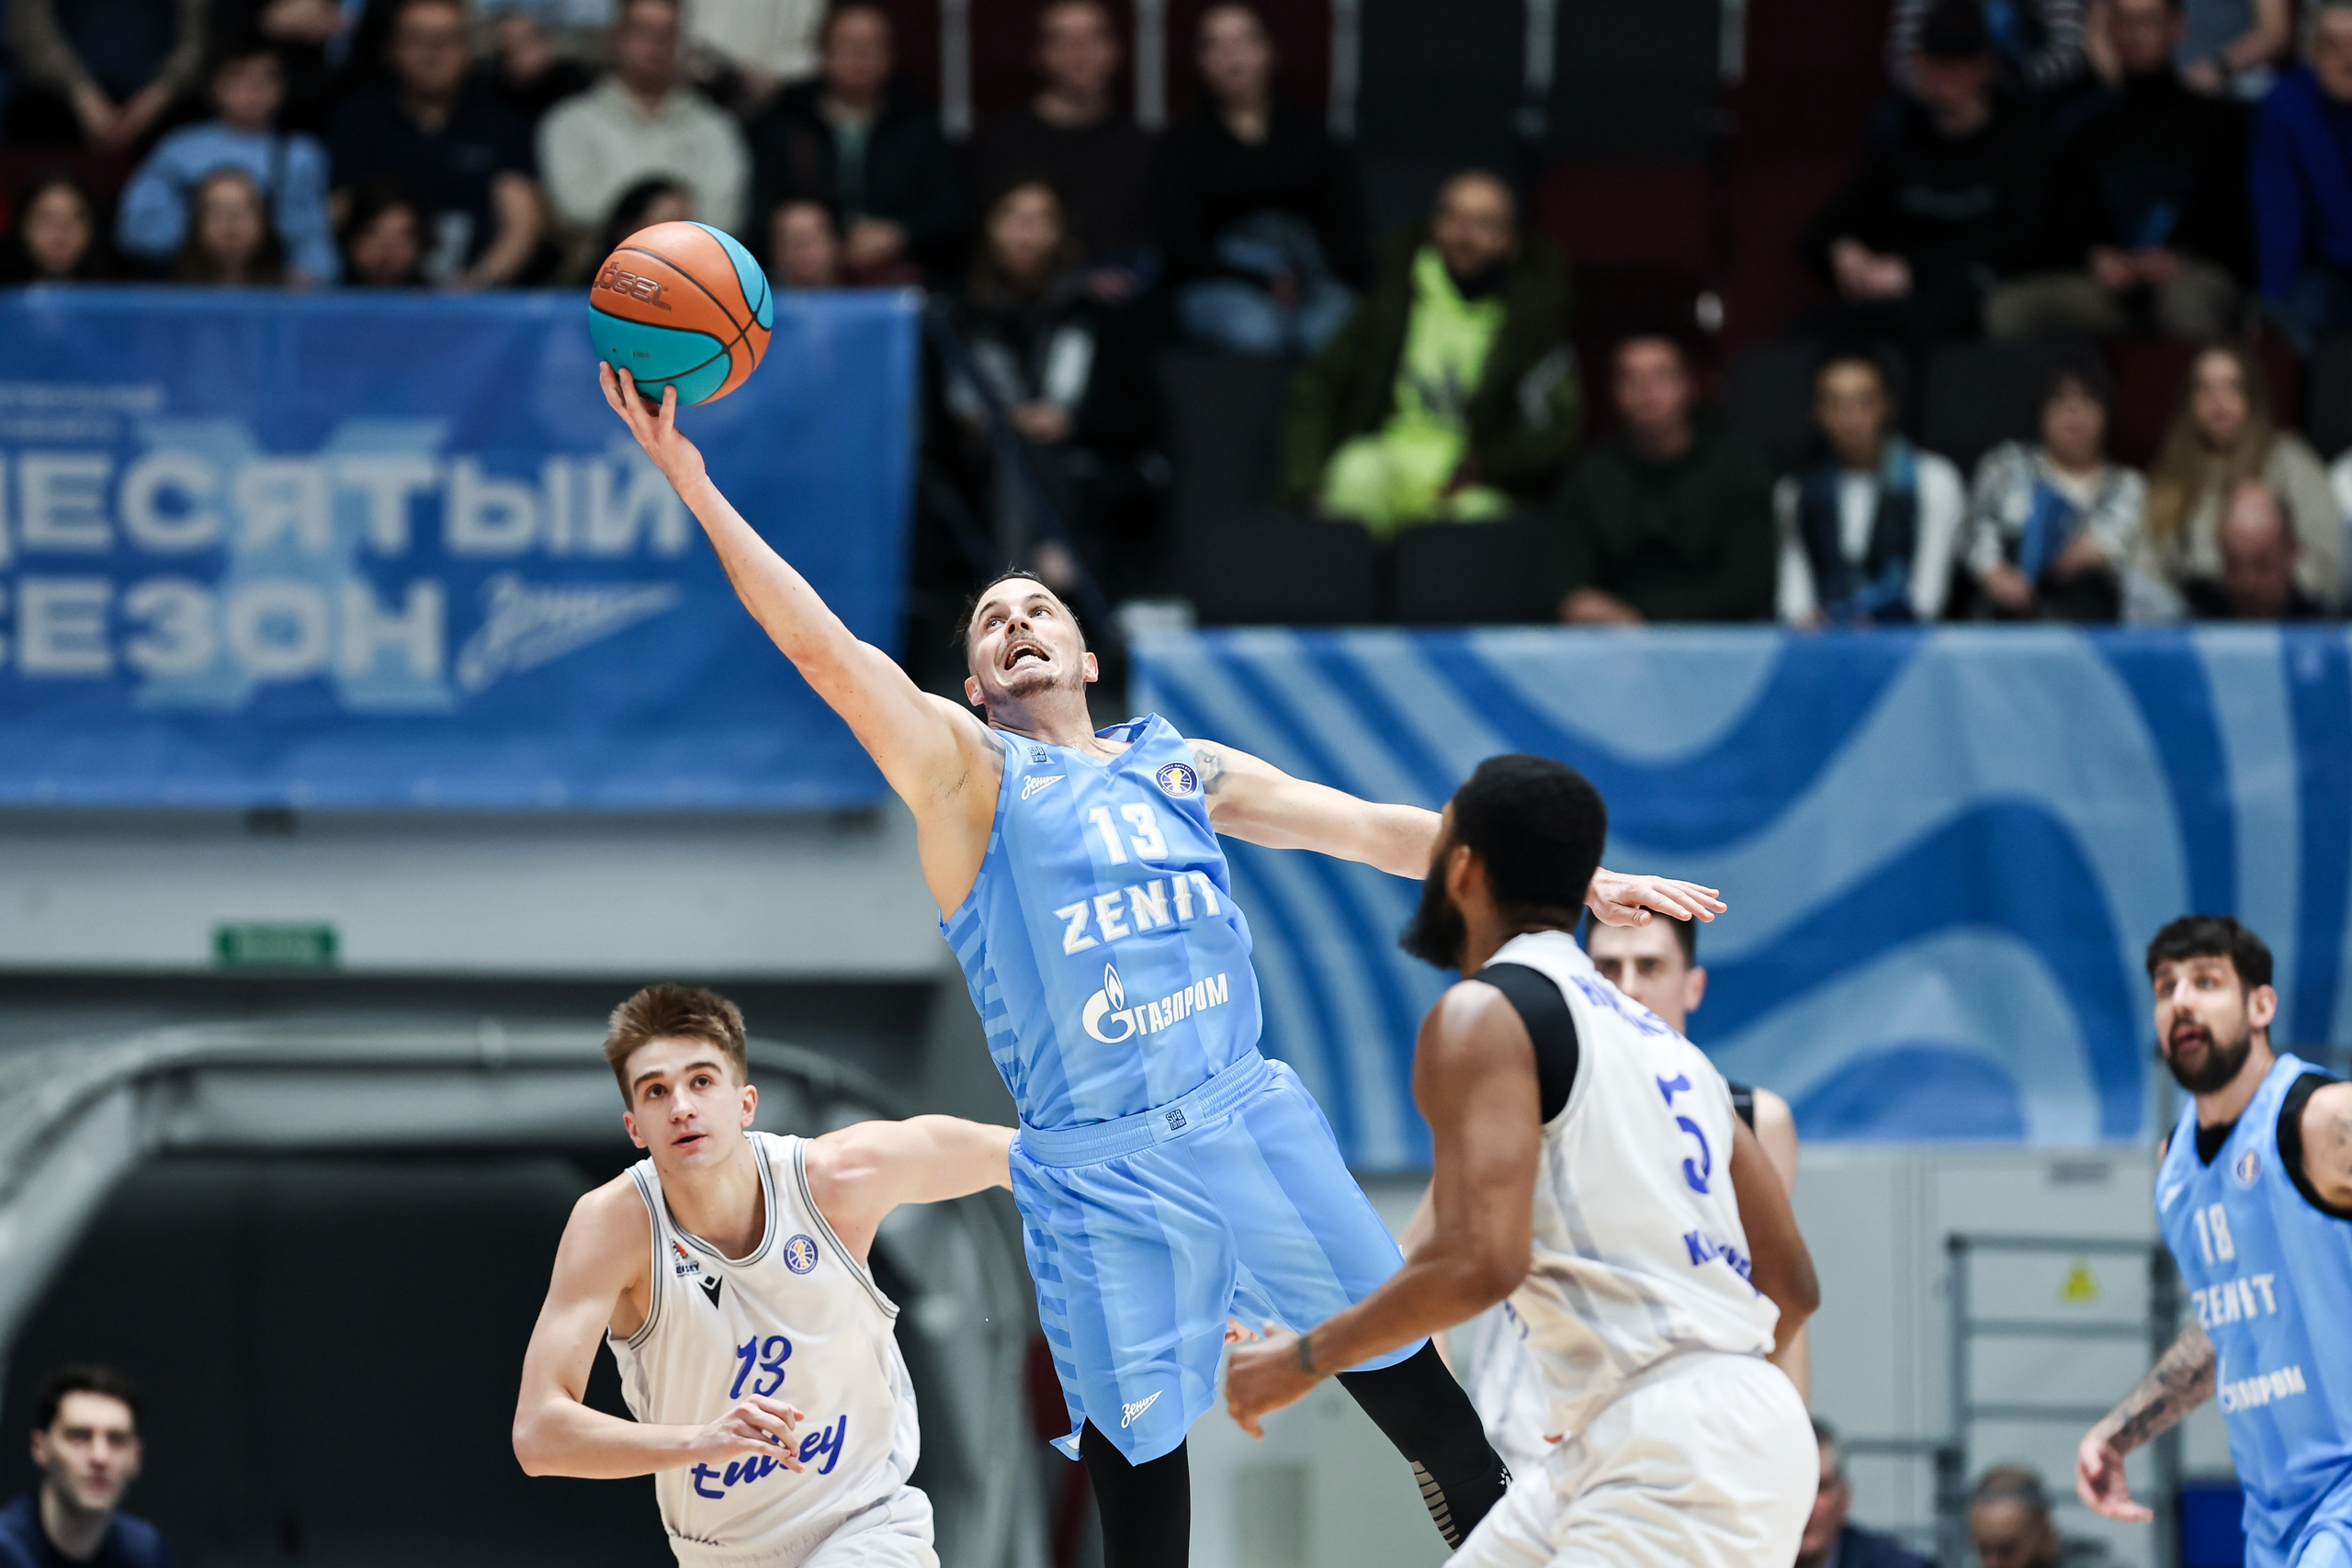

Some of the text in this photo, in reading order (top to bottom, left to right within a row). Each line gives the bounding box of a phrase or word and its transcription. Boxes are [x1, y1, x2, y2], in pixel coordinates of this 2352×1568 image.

[0, 444, 696, 555] ЕСЯТЫЙ
[0, 577, 450, 682] ЕЗОН
[1089, 802, 1170, 865] 13
[1052, 872, 1221, 956] ZENIT
[1135, 972, 1229, 1036] ГАЗПРОМ
[2195, 1202, 2235, 1267] 18
[2192, 1272, 2277, 1331] ZENIT
[730, 1335, 792, 1400] 13
[691, 1415, 847, 1499] Eniey
